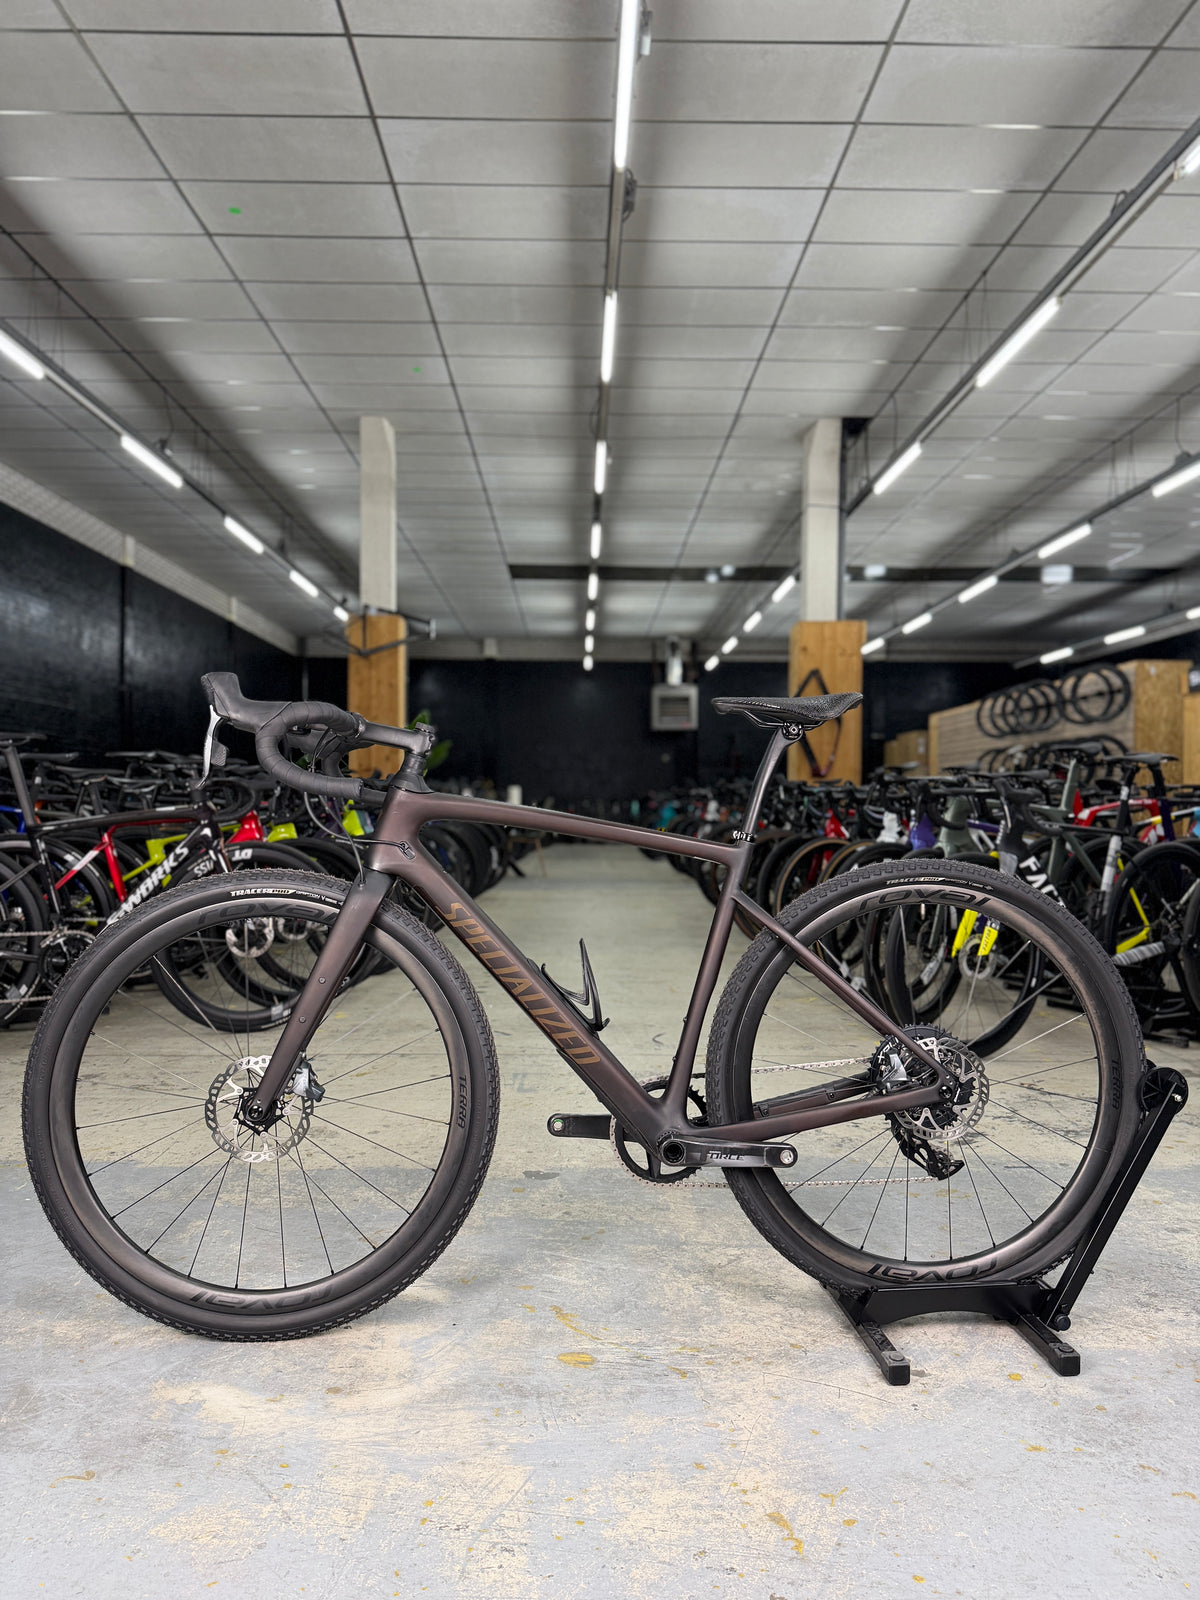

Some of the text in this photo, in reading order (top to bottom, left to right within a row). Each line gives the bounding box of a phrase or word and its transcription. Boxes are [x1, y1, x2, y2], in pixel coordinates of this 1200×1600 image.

[435, 902, 600, 1065] SPECIALIZED
[457, 1074, 467, 1129] TERRA
[1112, 1058, 1121, 1110] TERRA
